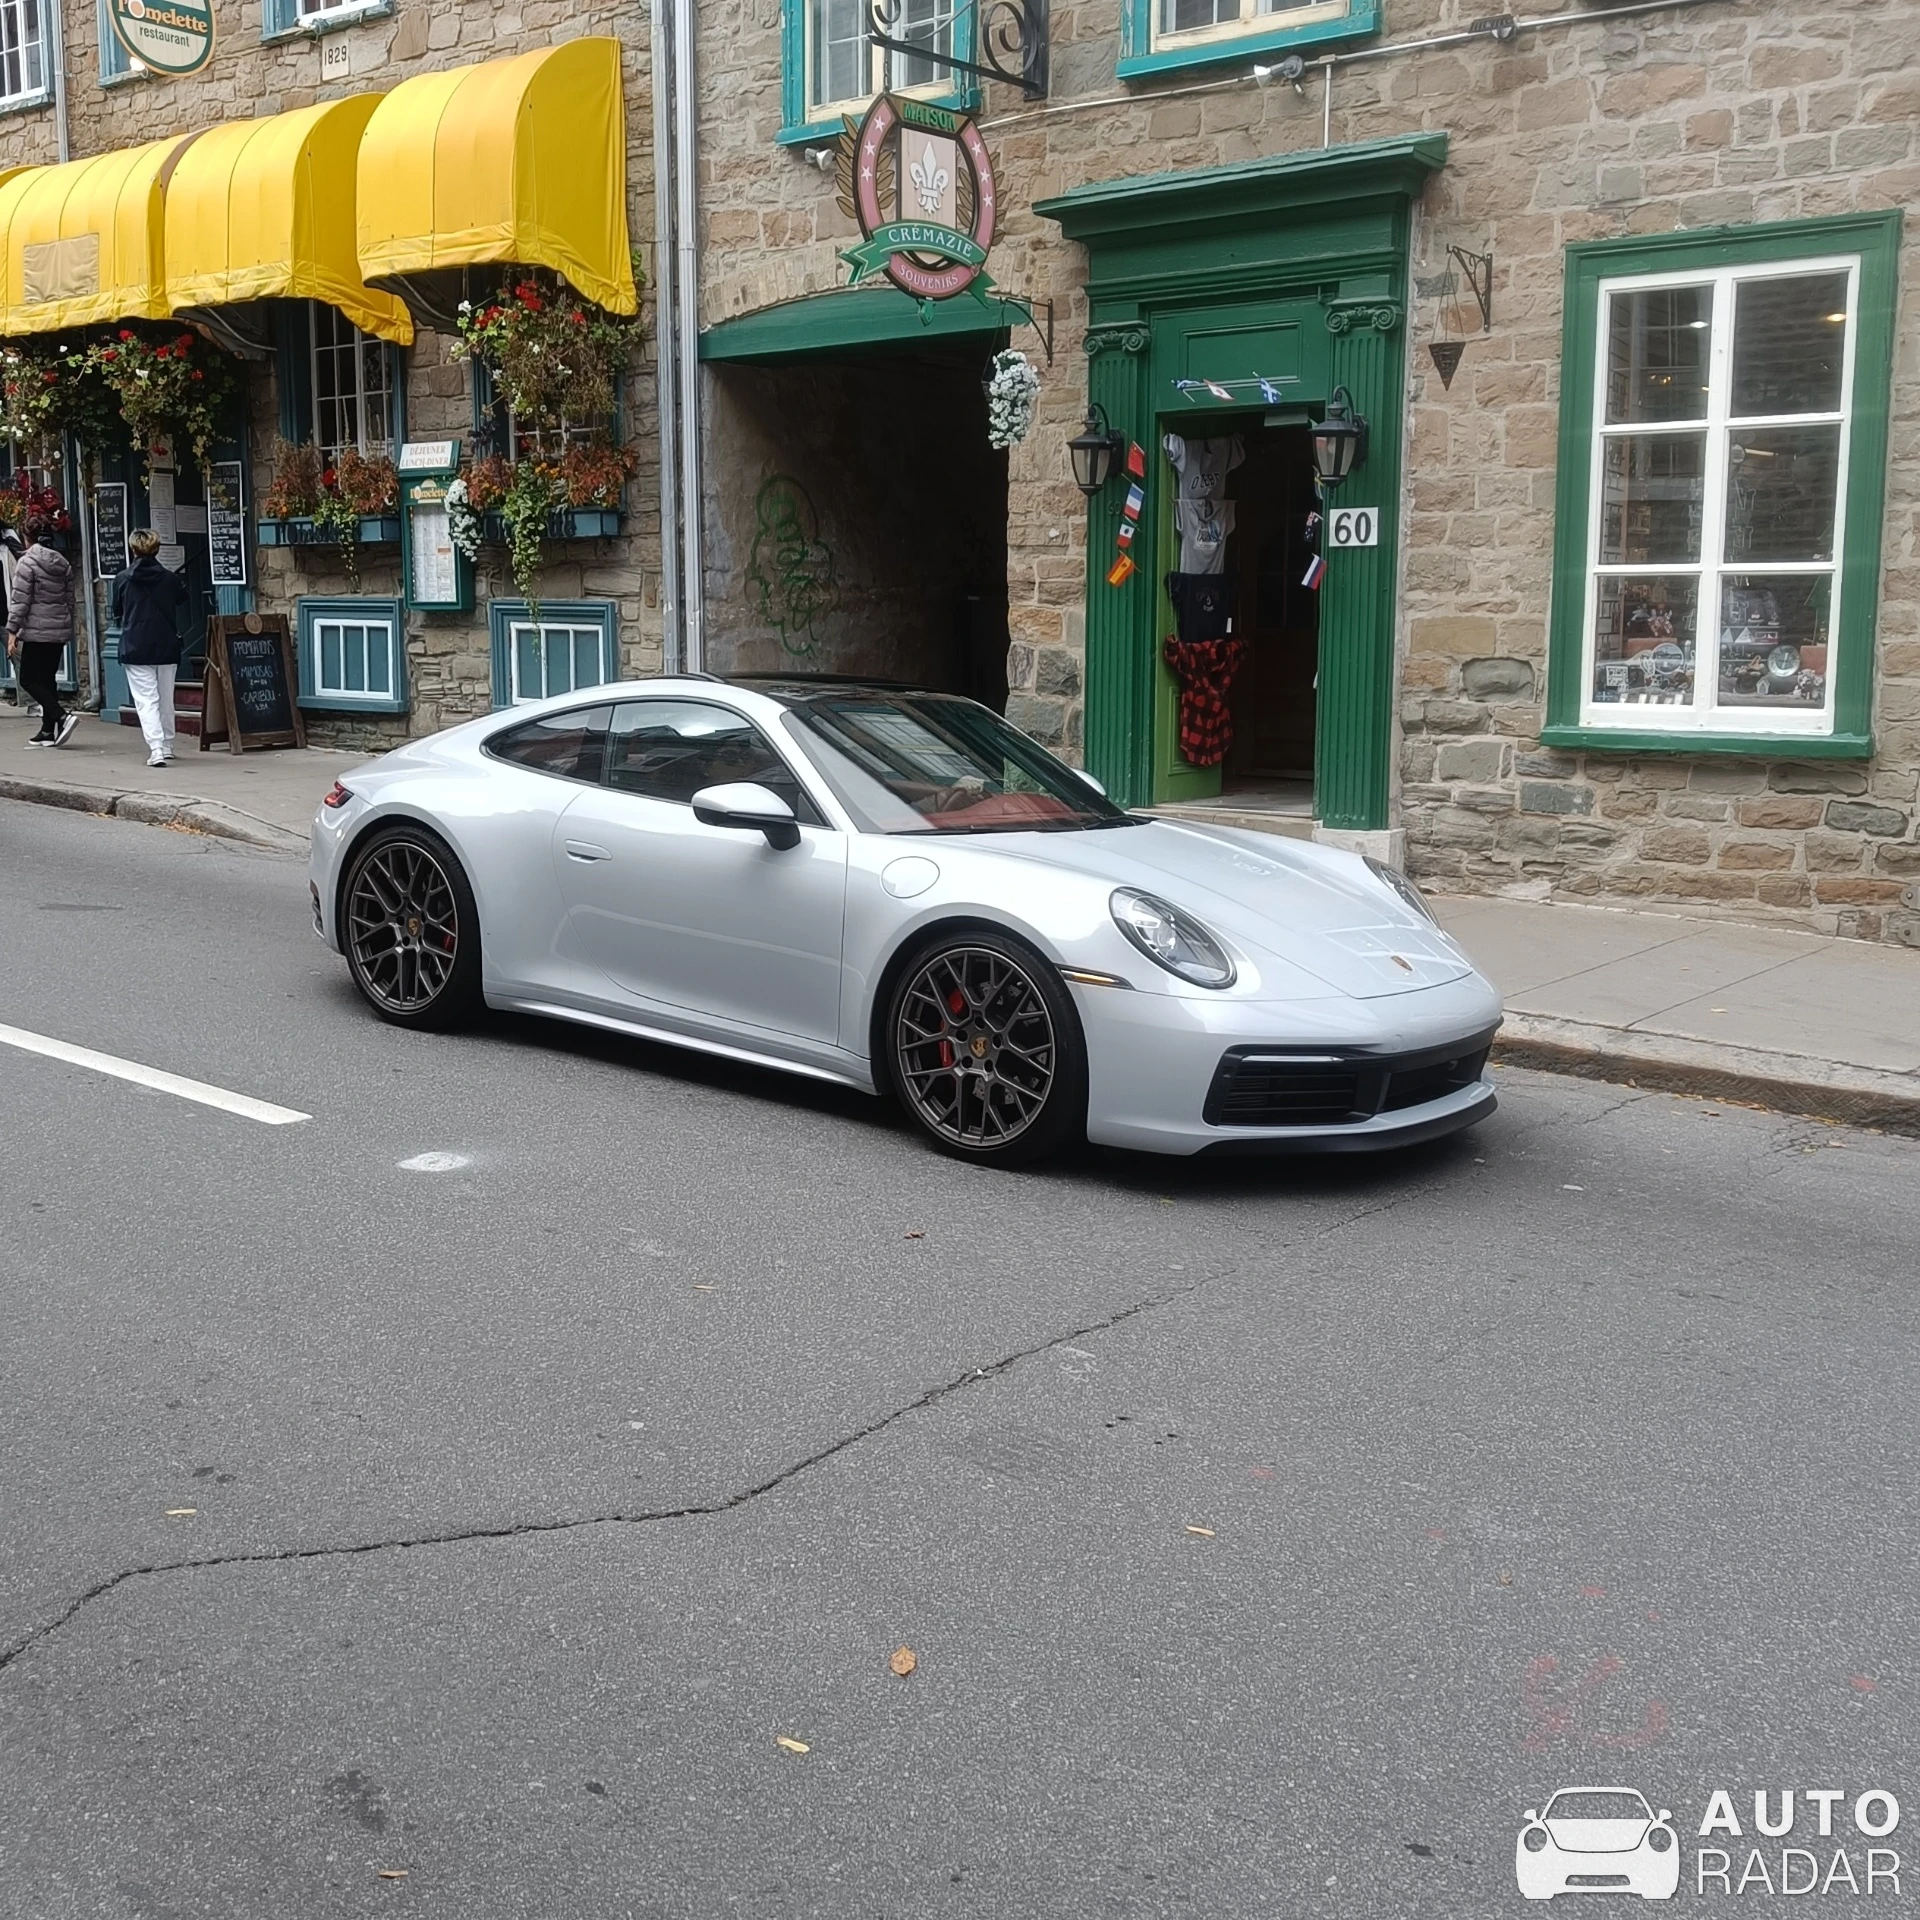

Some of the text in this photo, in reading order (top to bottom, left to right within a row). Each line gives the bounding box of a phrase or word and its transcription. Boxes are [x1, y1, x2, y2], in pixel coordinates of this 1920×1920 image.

[139, 25, 190, 47] restaurant
[324, 45, 347, 66] 1829
[904, 103, 956, 132] MAISON
[888, 224, 973, 257] CRÉMAZIE
[899, 264, 959, 290] SOUVENIRS
[1334, 511, 1372, 545] 60
[233, 640, 276, 656] PROMOTIONS
[240, 665, 274, 678] MIMOSAS
